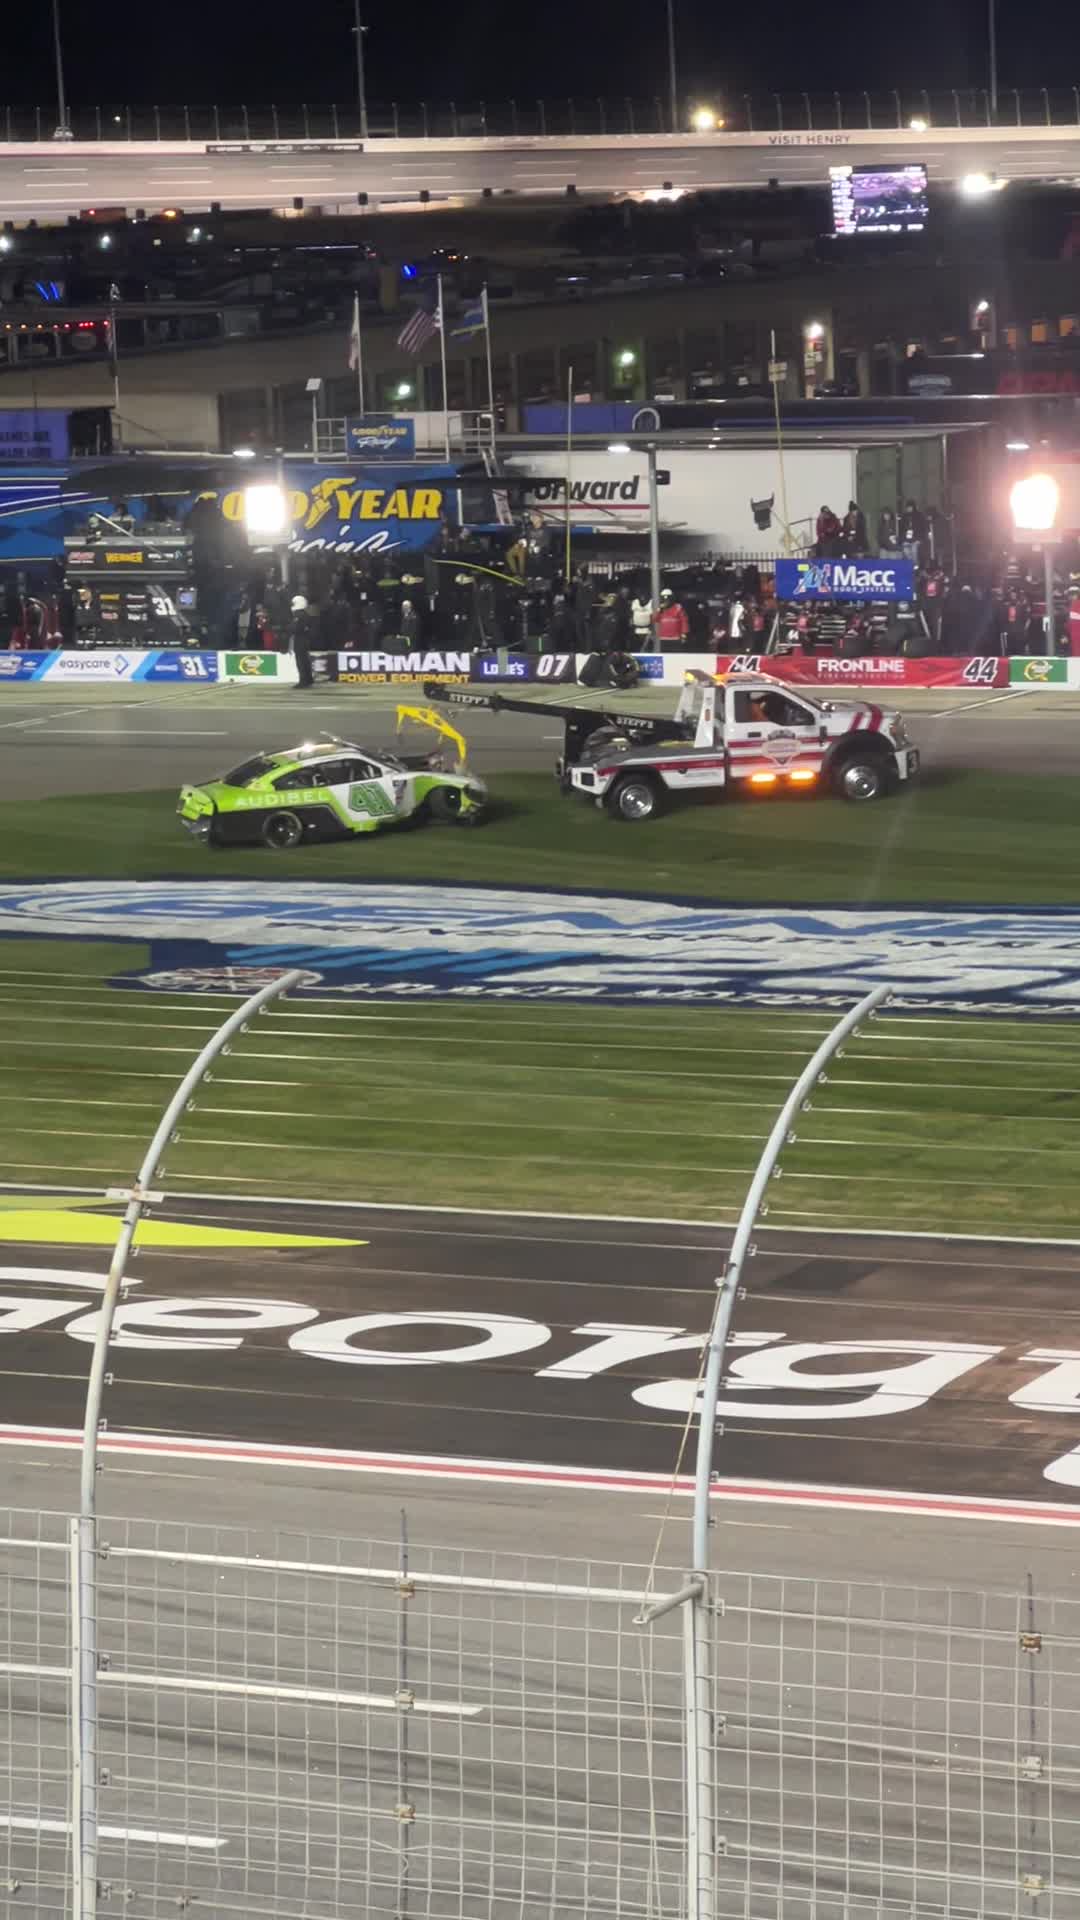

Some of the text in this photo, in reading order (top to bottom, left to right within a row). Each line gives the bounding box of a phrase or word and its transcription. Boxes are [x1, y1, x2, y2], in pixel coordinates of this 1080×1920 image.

[768, 134, 850, 145] VISIT HENRY
[833, 565, 896, 587] Macc
[151, 596, 177, 615] 31
[60, 659, 111, 670] easycare
[179, 655, 209, 678] 31
[337, 651, 471, 672] FIRMAN
[536, 654, 570, 677] 07
[817, 659, 905, 672] FRONTLINE
[963, 657, 999, 683] 44
[338, 673, 470, 684] POWER EQUIPMENT
[235, 789, 327, 809] AUDIBEL
